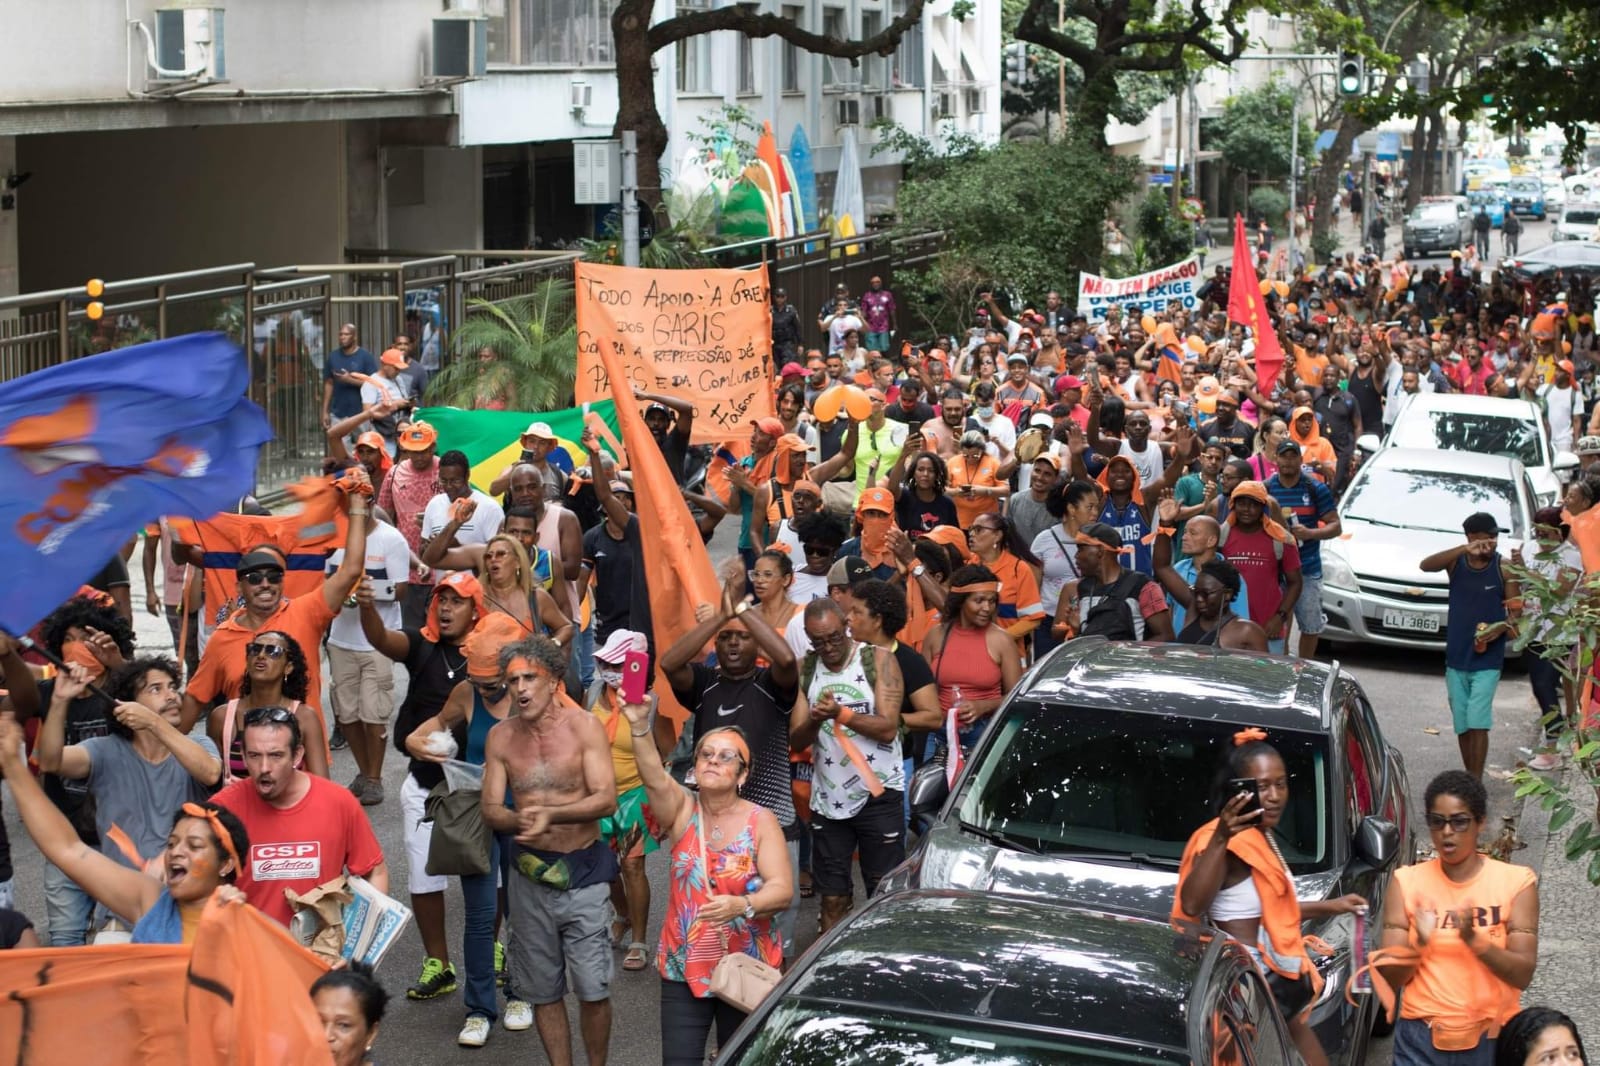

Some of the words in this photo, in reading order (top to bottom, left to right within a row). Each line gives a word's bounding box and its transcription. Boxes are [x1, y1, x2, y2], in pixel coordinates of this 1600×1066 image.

[580, 276, 631, 306] TODO
[1082, 275, 1113, 294] NÃO
[1118, 279, 1143, 295] TEM
[1147, 281, 1192, 298] EXIGE
[617, 320, 645, 333] DOS
[633, 346, 643, 359] A
[655, 376, 667, 390] E
[257, 845, 315, 858] CSP
[259, 859, 314, 873] Conlutas
